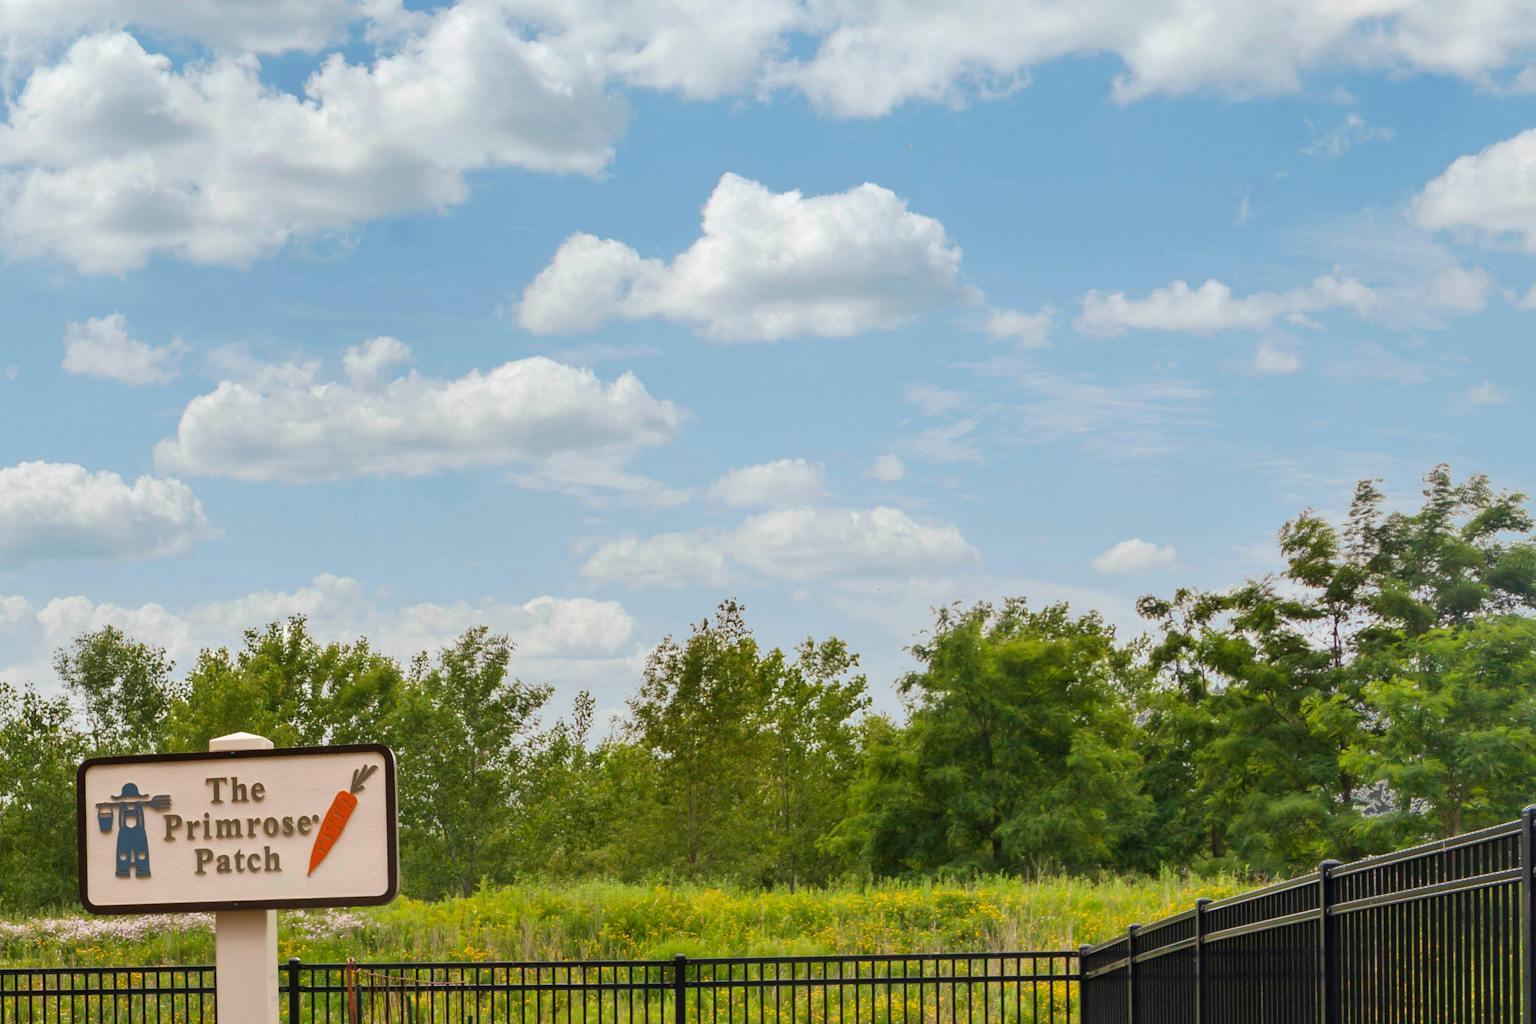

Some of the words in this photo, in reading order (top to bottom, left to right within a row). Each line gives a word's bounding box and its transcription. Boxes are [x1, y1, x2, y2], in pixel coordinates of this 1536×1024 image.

[205, 776, 265, 804] The
[163, 812, 313, 841] Primrose
[194, 846, 282, 875] Patch
